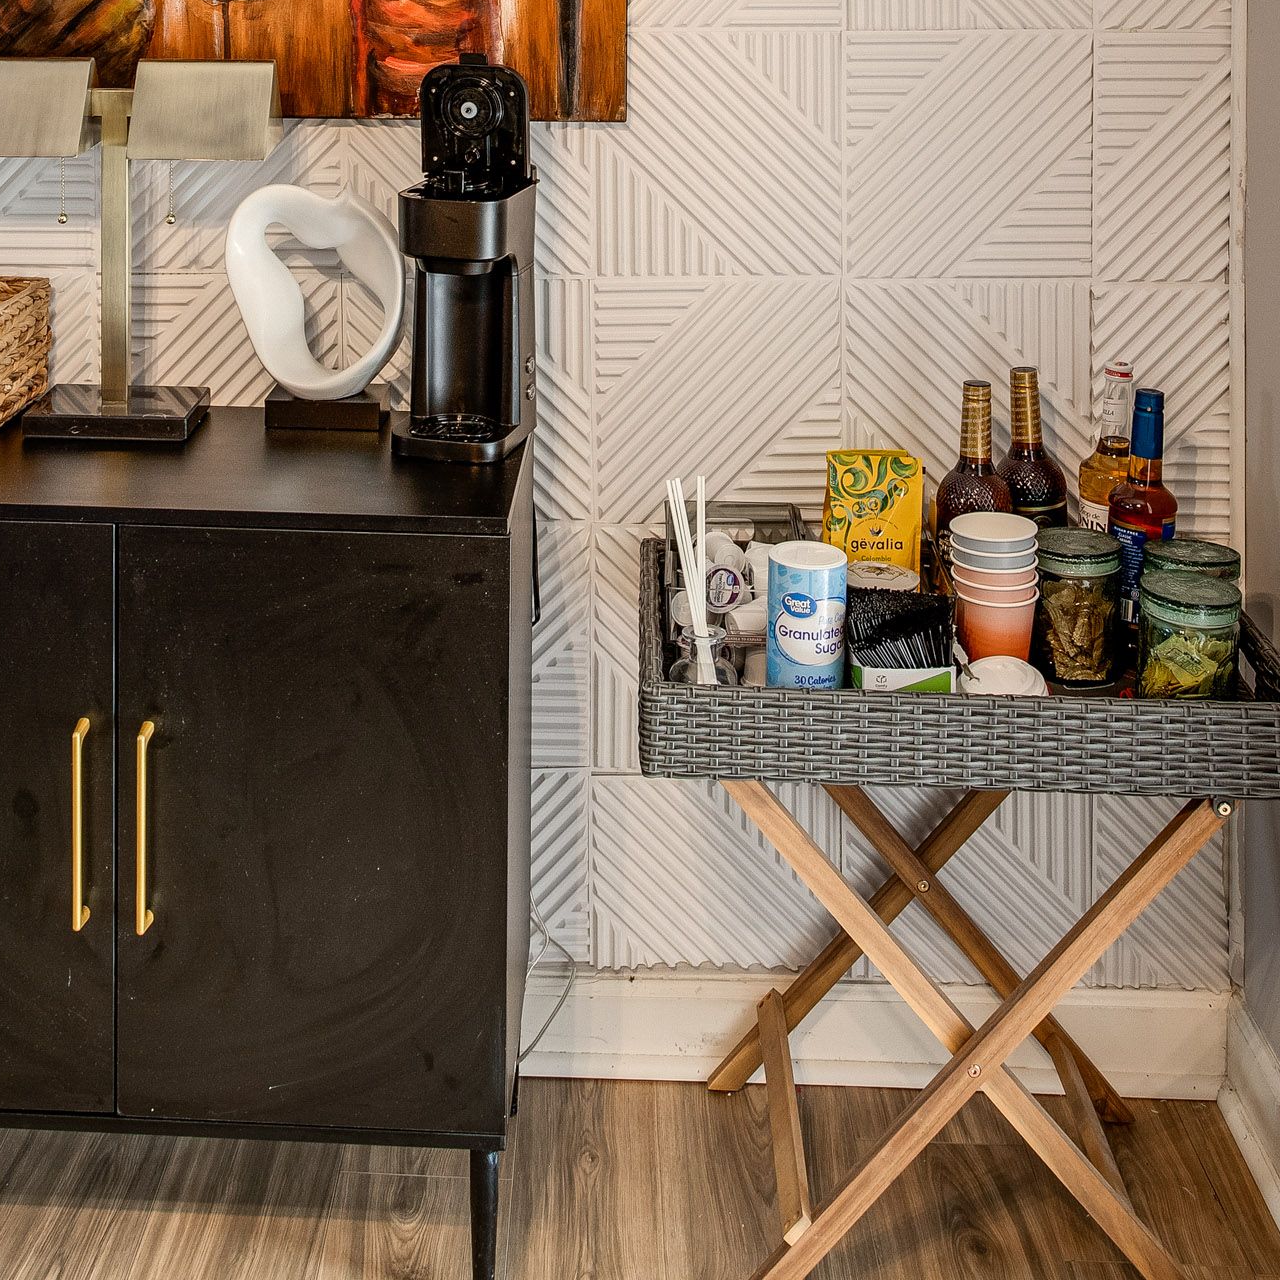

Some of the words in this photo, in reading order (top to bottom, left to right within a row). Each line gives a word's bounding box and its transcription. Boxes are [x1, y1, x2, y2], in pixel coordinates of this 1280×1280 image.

[850, 538, 903, 552] gëvalia
[784, 596, 811, 608] Great
[790, 605, 811, 614] Value
[815, 640, 842, 655] Suga
[794, 675, 807, 685] 30
[807, 674, 837, 685] Calories
